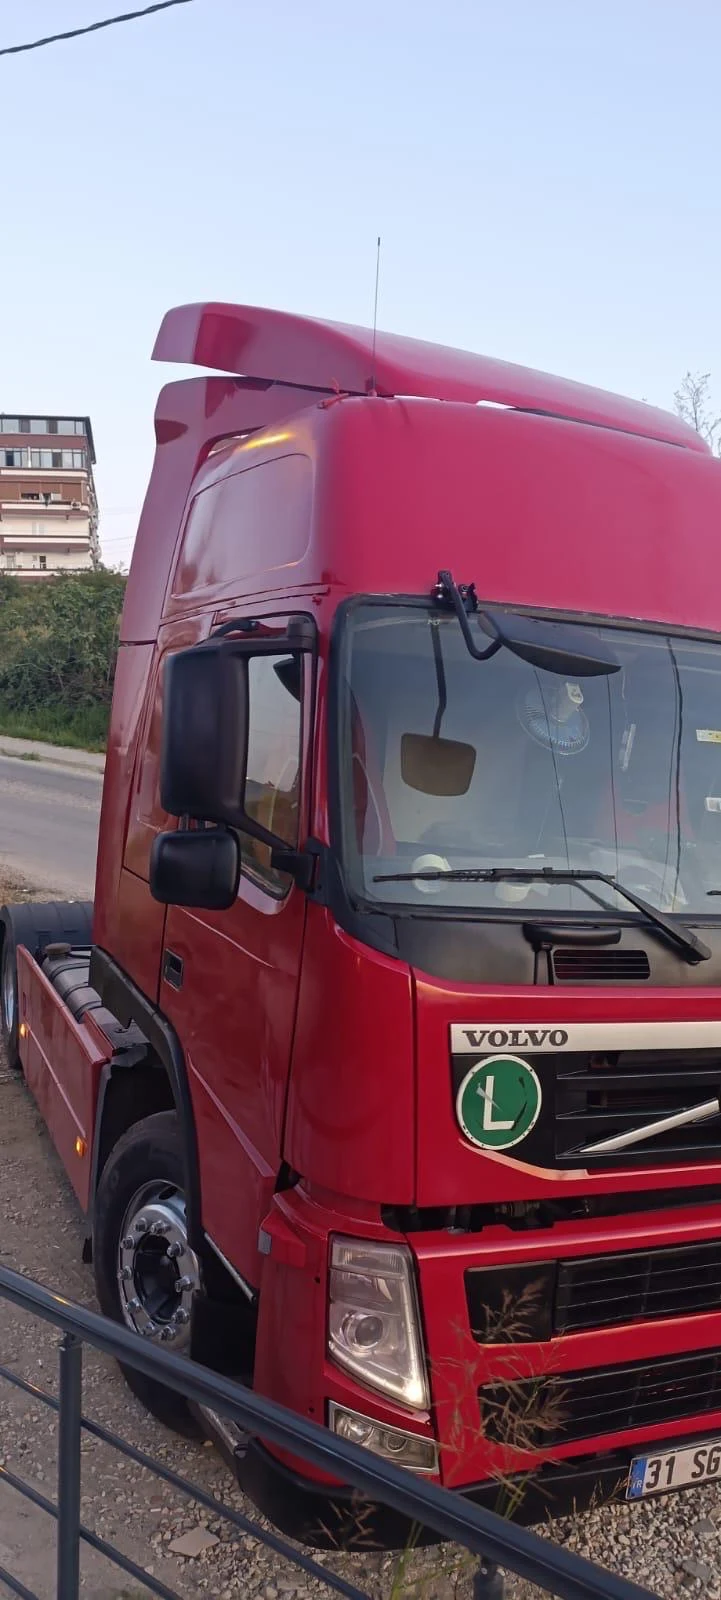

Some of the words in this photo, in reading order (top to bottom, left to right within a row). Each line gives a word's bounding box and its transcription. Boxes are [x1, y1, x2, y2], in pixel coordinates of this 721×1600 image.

[462, 1029, 568, 1046] VOLVO
[483, 1076, 515, 1130] L
[645, 1456, 676, 1489] 31
[691, 1446, 721, 1479] SG
